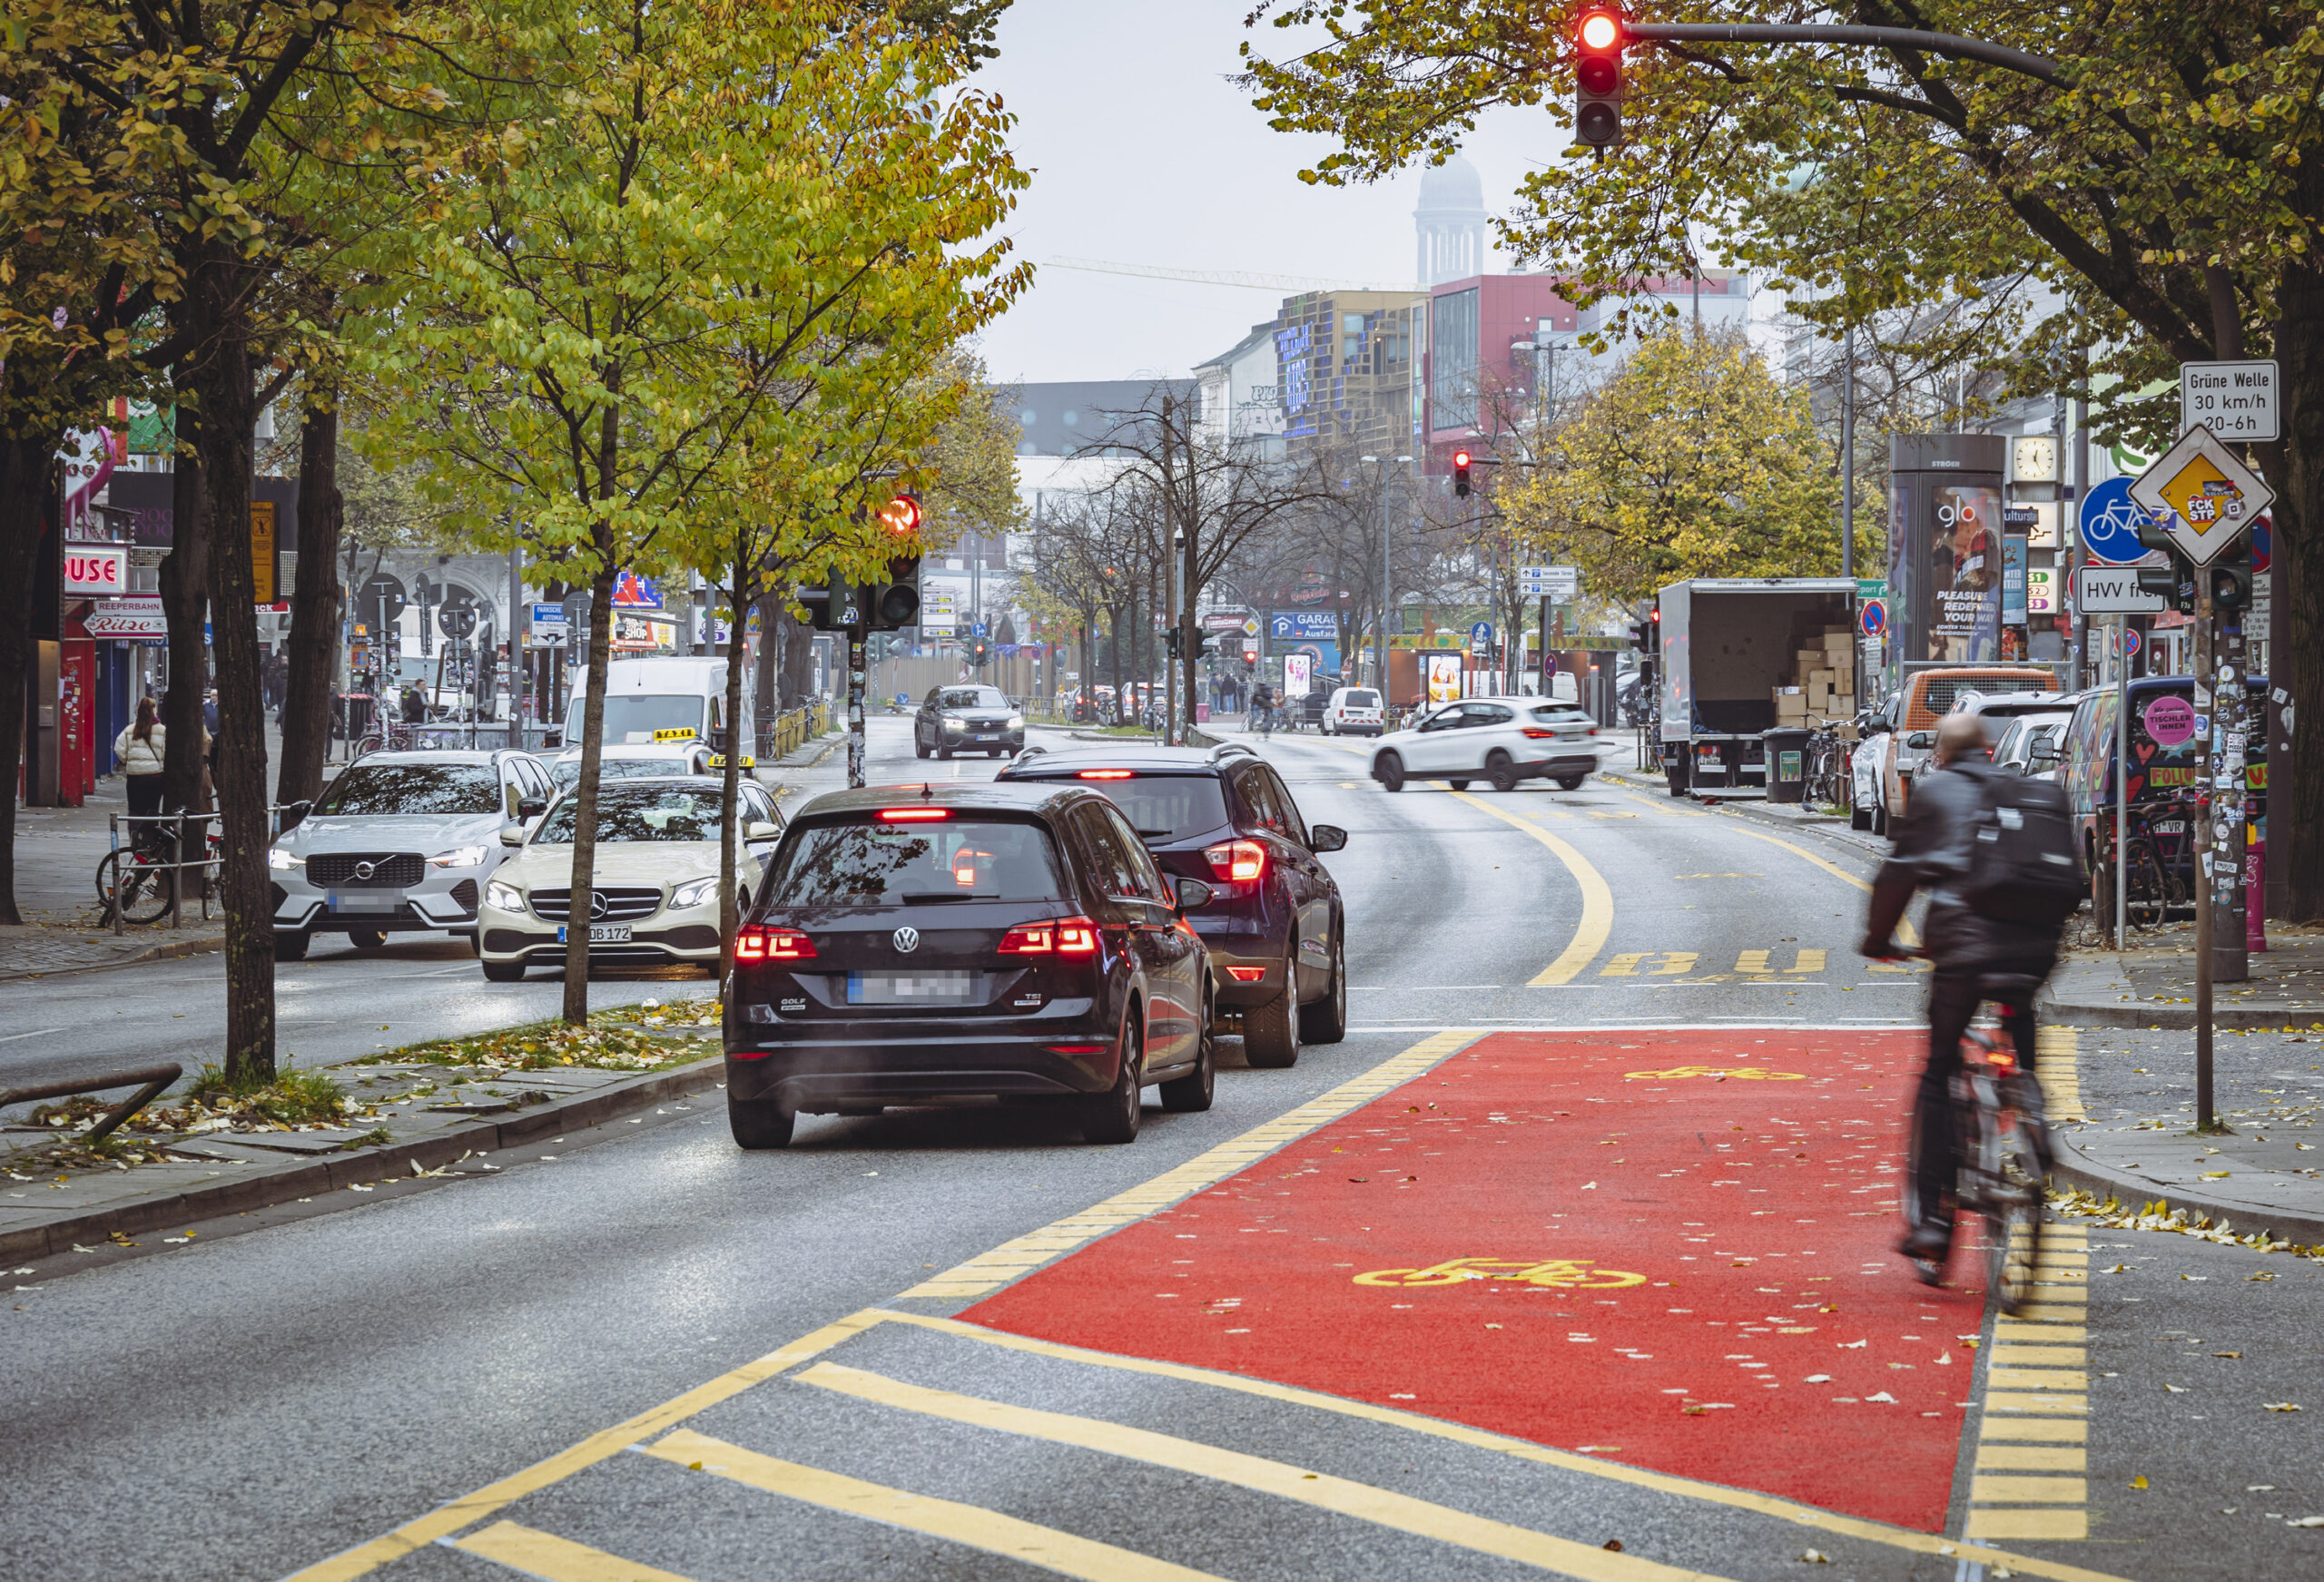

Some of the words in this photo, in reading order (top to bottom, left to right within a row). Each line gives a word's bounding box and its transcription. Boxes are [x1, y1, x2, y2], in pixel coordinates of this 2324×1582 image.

[2191, 373, 2227, 388] Grüne
[2234, 372, 2269, 387] Welle
[2195, 395, 2214, 409] 30
[2223, 394, 2266, 409] km/h
[2205, 416, 2256, 430] 20-6h
[2188, 499, 2214, 510] FCK
[1938, 495, 1975, 528] glo
[2190, 510, 2215, 521] STP
[2028, 574, 2042, 582] S1
[2087, 582, 2122, 598] HVV
[1936, 591, 1989, 601] PLEASURE
[99, 603, 160, 611] REEPERBAHN
[1945, 612, 1974, 623] YOUR
[1977, 613, 1994, 623] WAY
[89, 617, 151, 631] Ritze
[625, 627, 647, 639] SHOP
[2150, 714, 2191, 723] TISCHLER
[657, 729, 692, 739] TAXI
[2152, 767, 2195, 785] FOLLO
[2168, 821, 2181, 832] VR
[607, 928, 628, 939] 172
